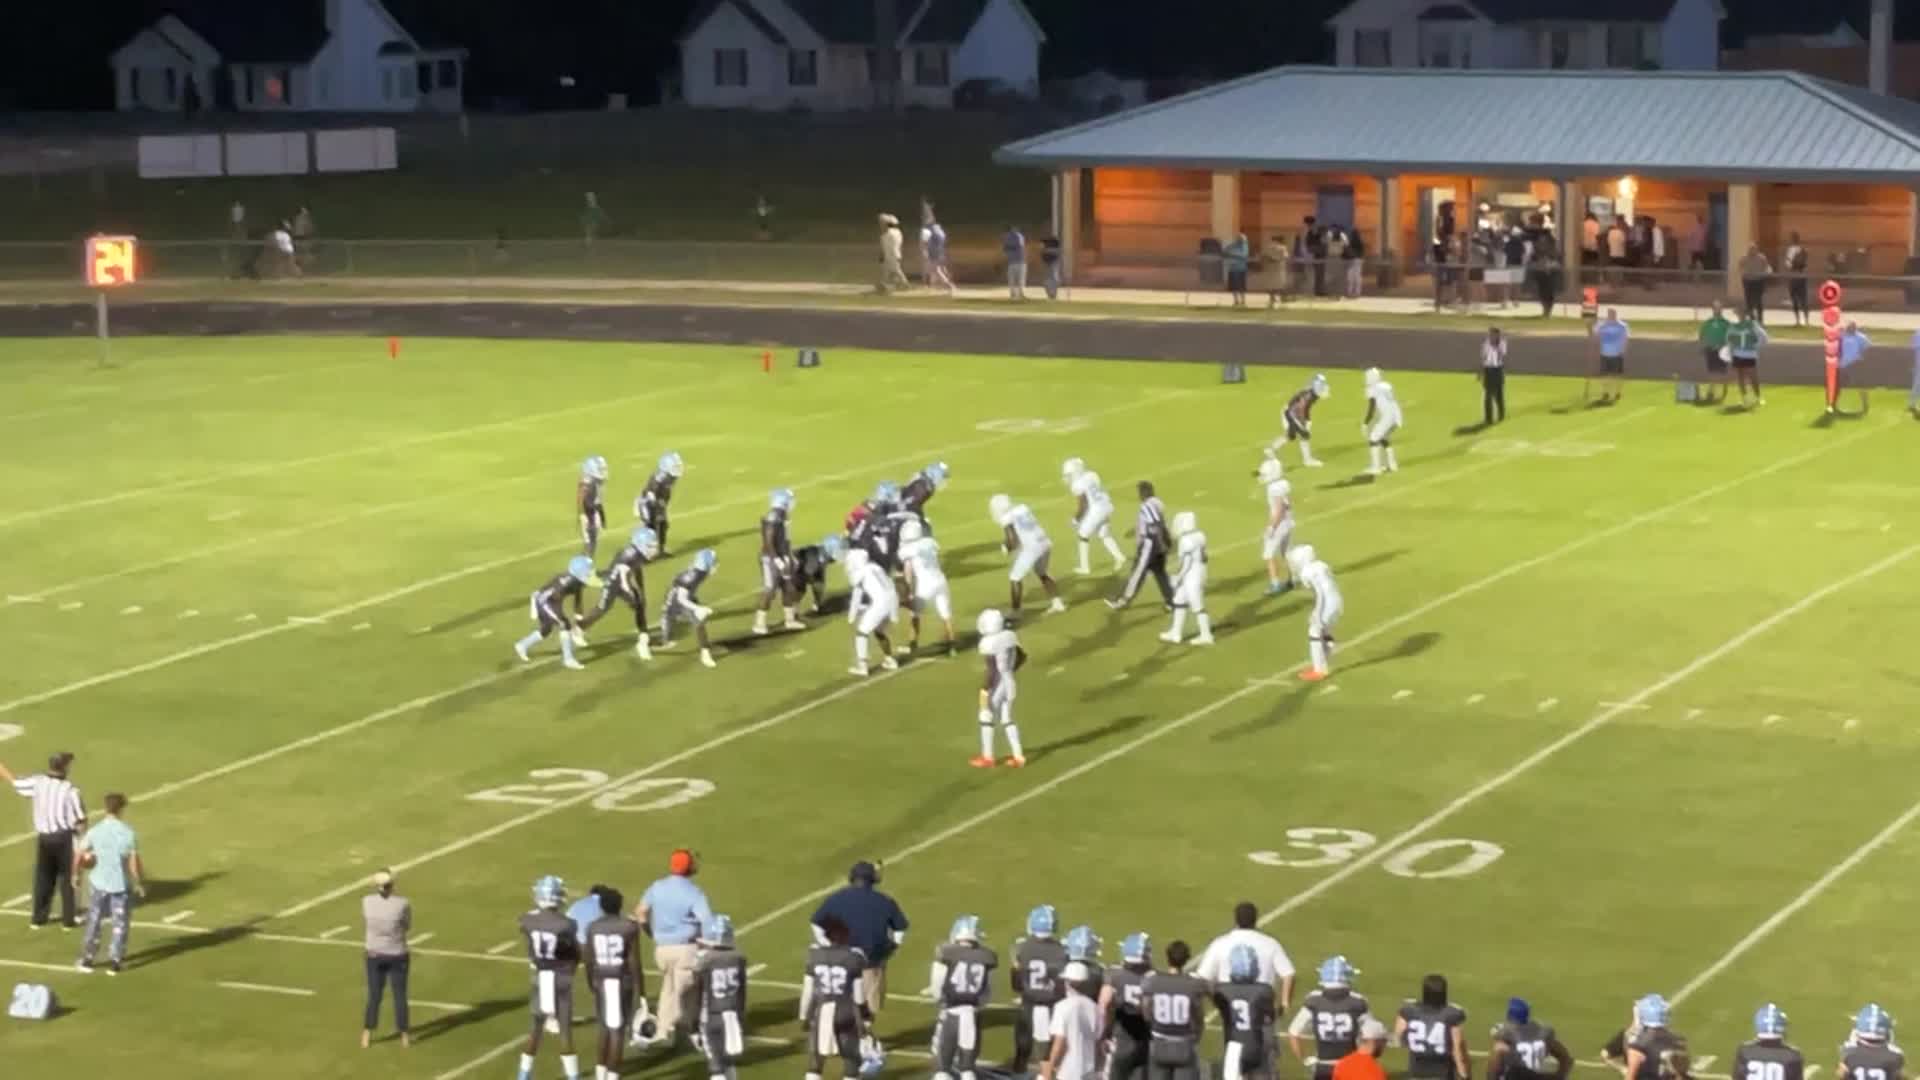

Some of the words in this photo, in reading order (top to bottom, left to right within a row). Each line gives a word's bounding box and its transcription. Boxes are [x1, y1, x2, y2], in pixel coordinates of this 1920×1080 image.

[93, 240, 134, 284] 24
[464, 767, 716, 811] 20
[1247, 827, 1504, 878] 30
[531, 930, 557, 959] 17
[814, 964, 848, 995] 32
[950, 961, 985, 992] 43
[1153, 993, 1190, 1025] 80
[1231, 999, 1250, 1030] 3
[1317, 1012, 1352, 1041] 22
[1407, 1020, 1447, 1053] 24
